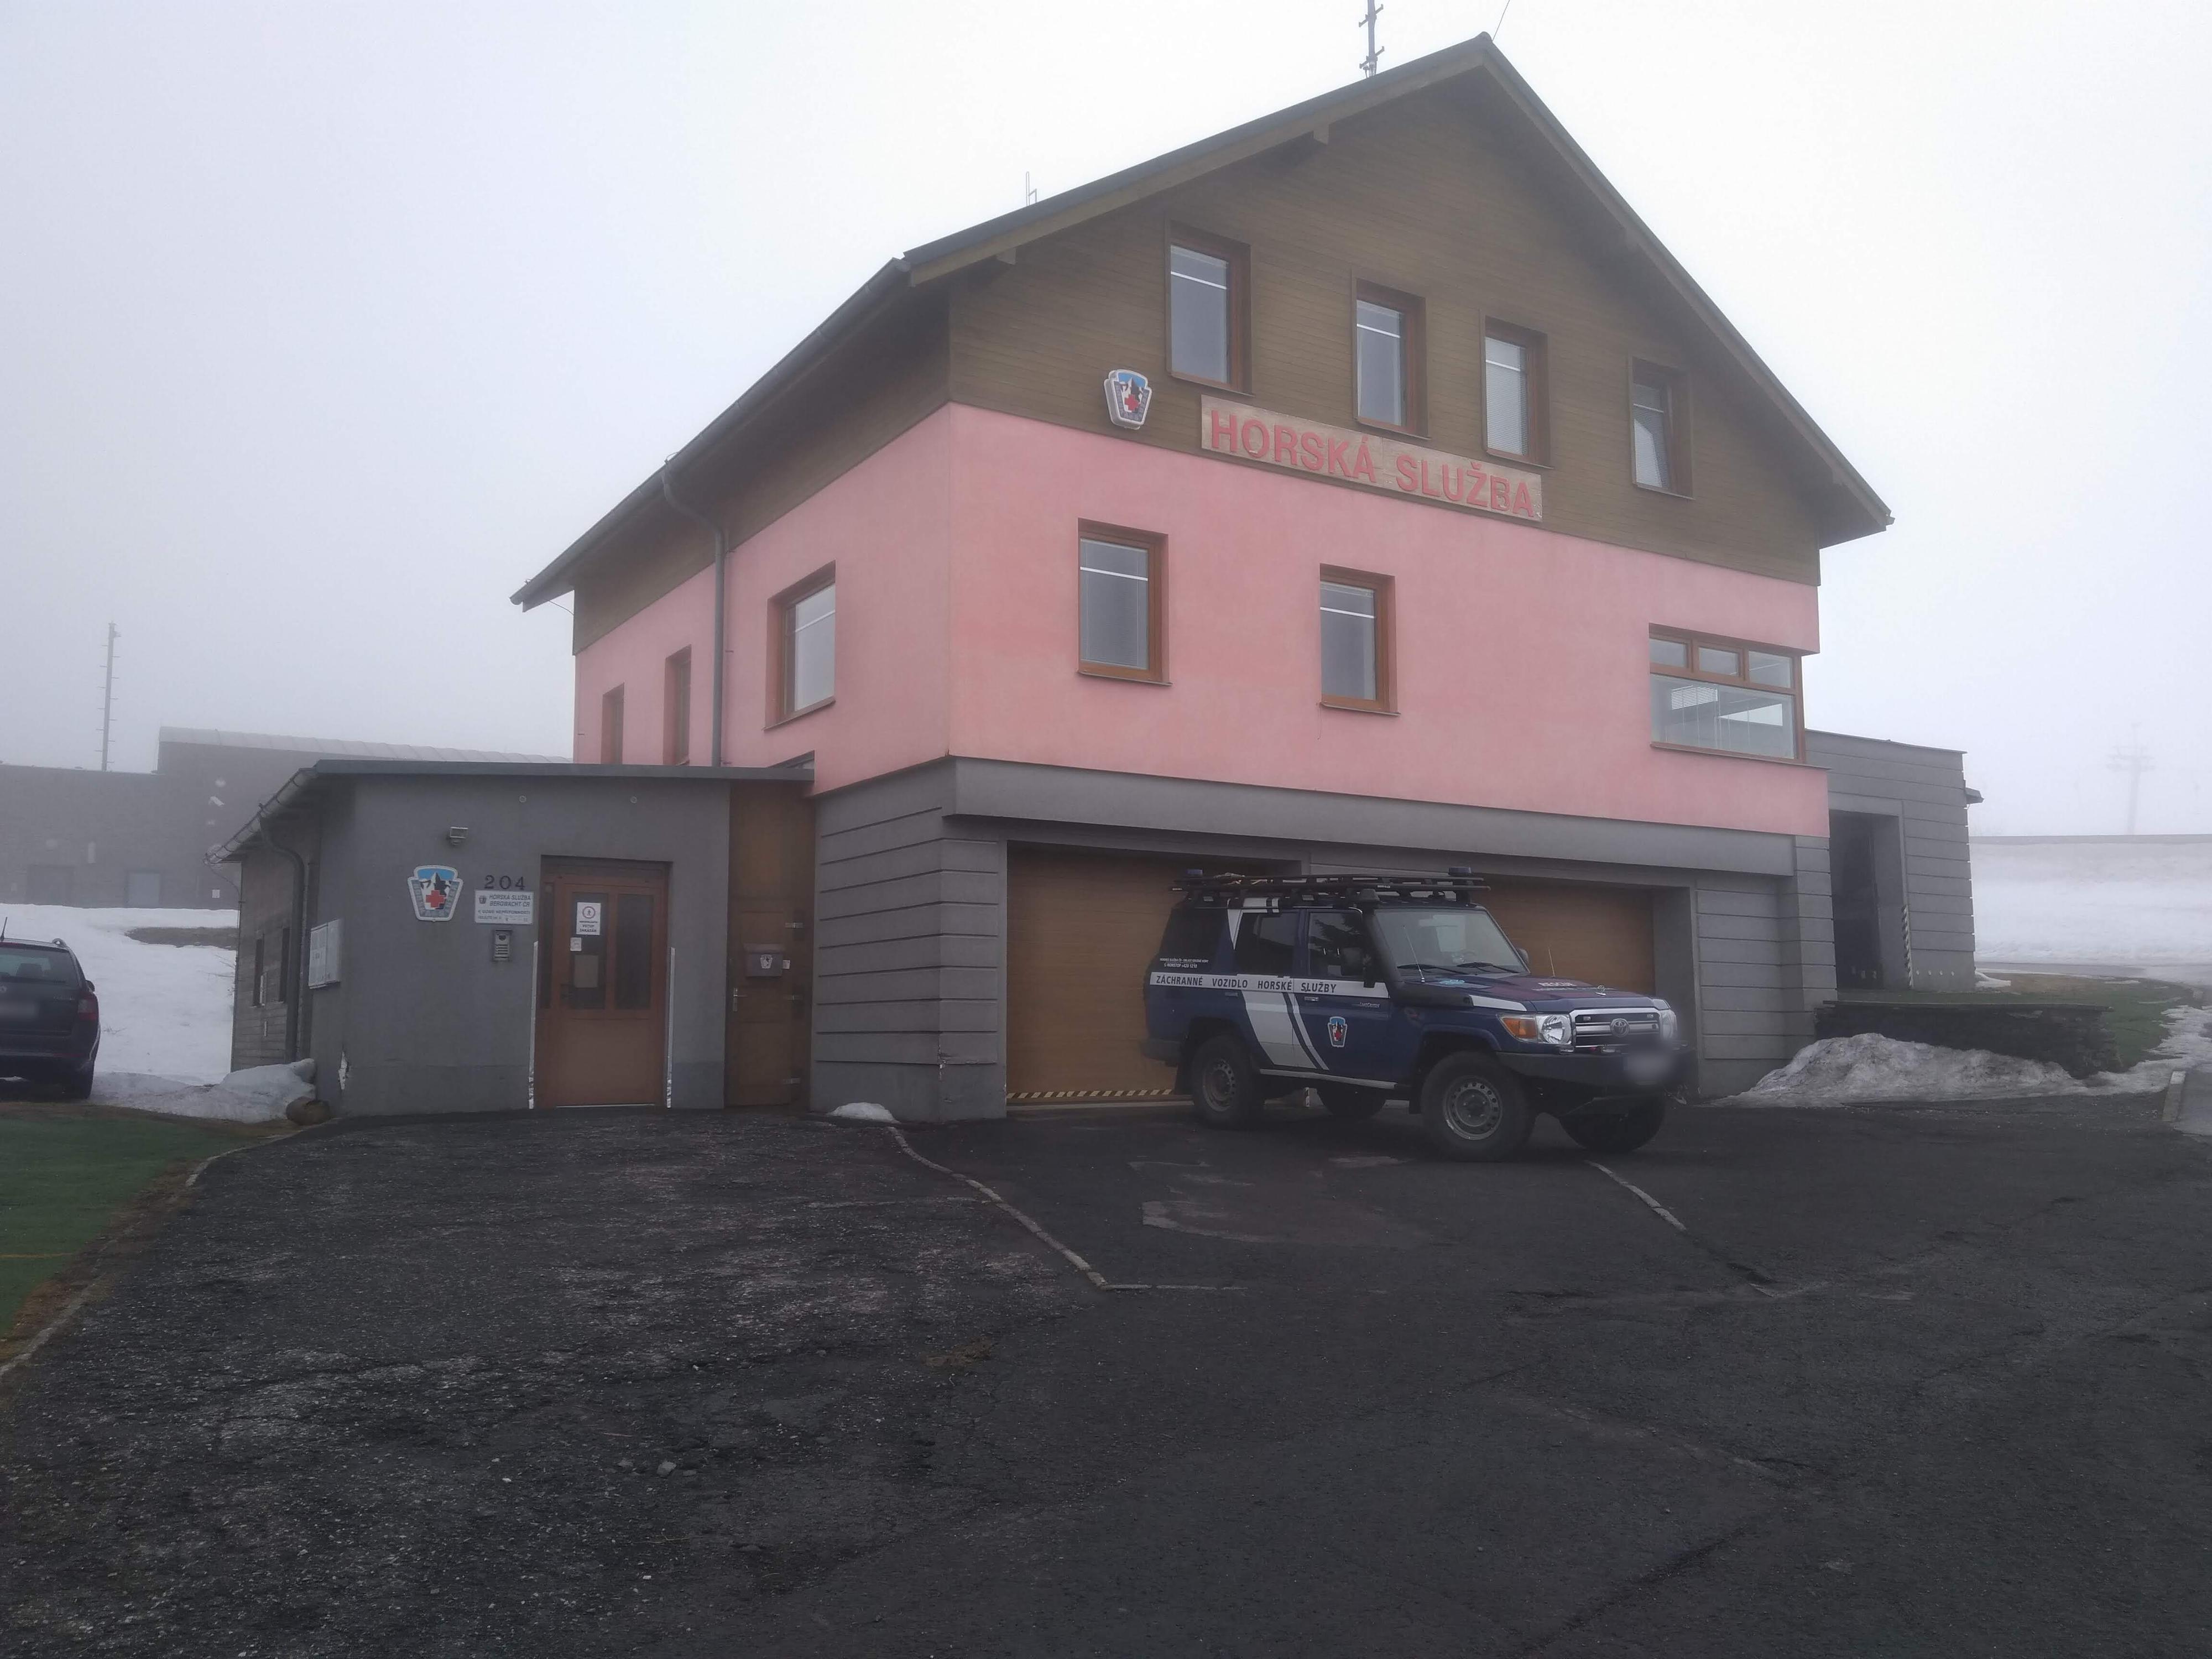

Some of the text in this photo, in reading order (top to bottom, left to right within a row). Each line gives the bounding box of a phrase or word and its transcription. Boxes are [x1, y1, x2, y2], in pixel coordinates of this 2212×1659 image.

[1212, 410, 1534, 517] HORSKÁ SLUŽBA
[484, 875, 525, 890] 204
[1156, 975, 1337, 993] ZÁCHRANNÉ VOZIDLO HORSKÉ SLUŽBY
